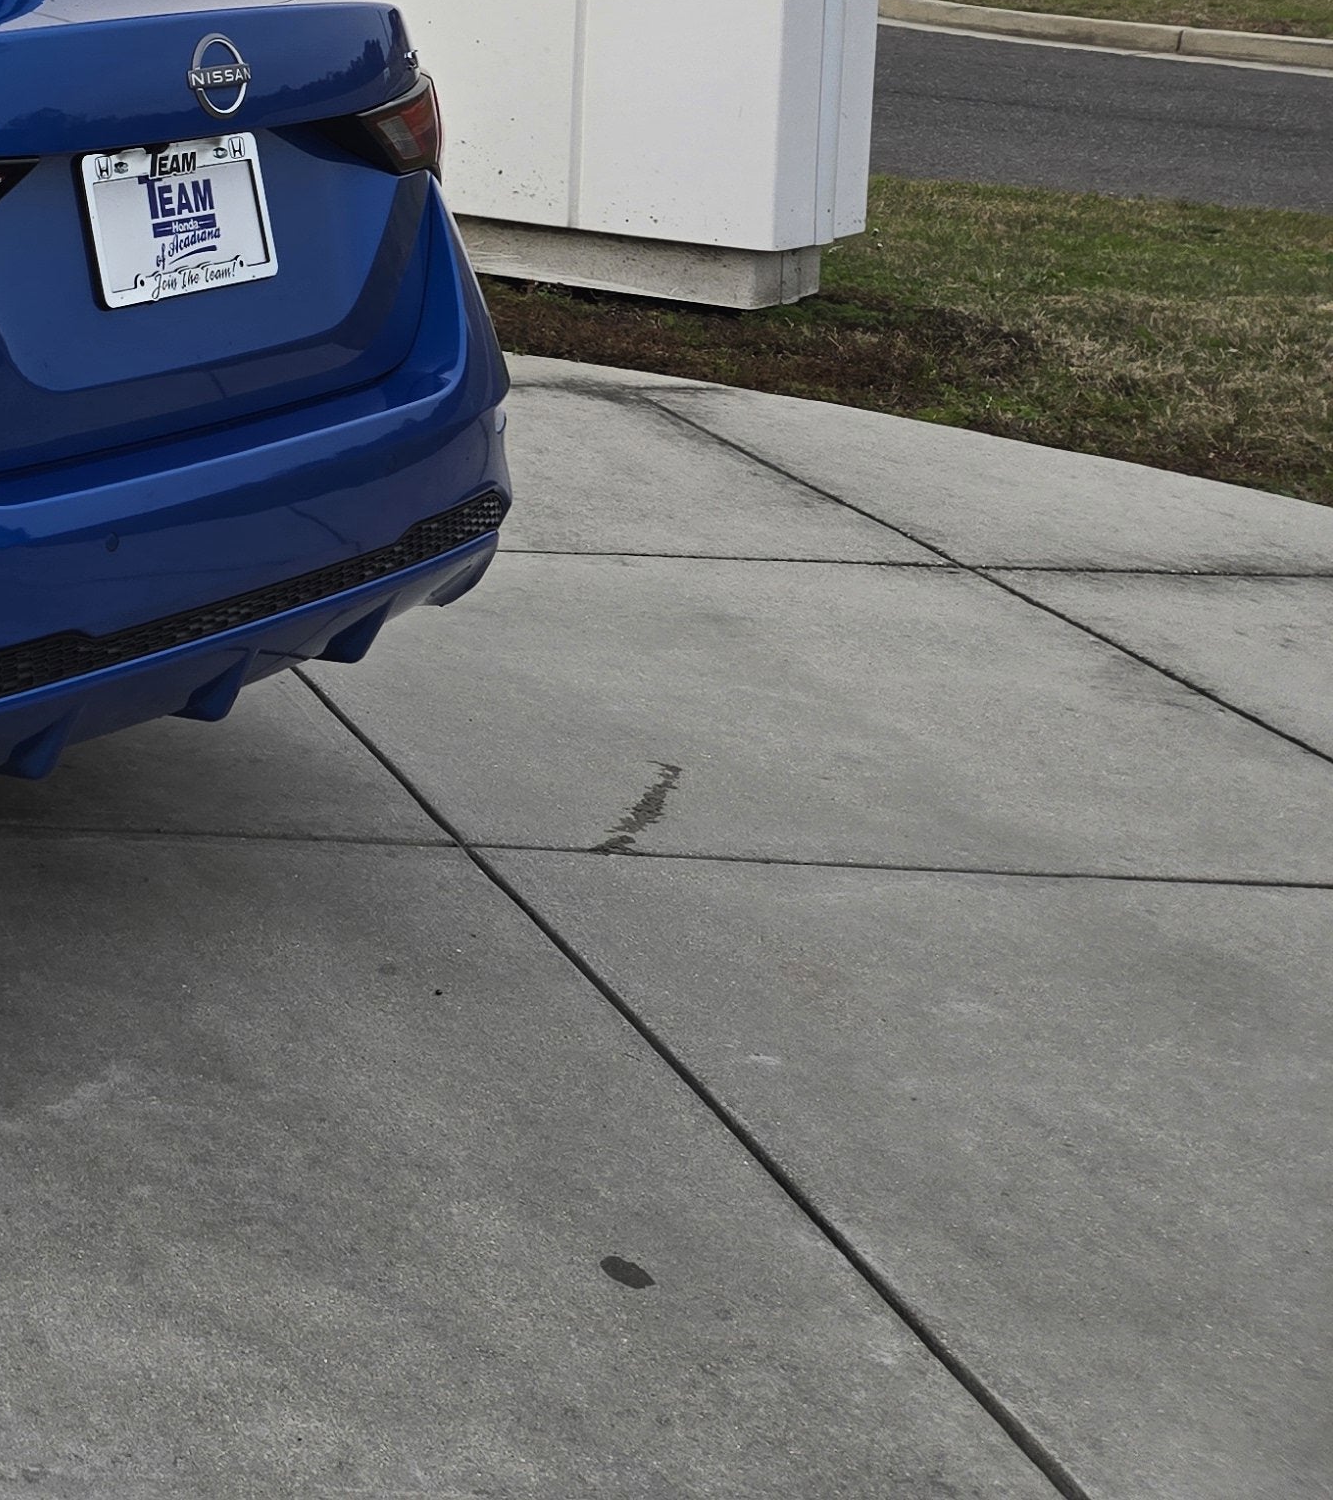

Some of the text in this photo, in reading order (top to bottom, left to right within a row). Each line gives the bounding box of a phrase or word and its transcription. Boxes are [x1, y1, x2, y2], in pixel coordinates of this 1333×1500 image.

[190, 67, 252, 87] NISSAN
[137, 175, 215, 220] TEAM
[172, 219, 200, 233] Honda
[155, 227, 221, 271] of Acadiana
[151, 273, 177, 299] Join
